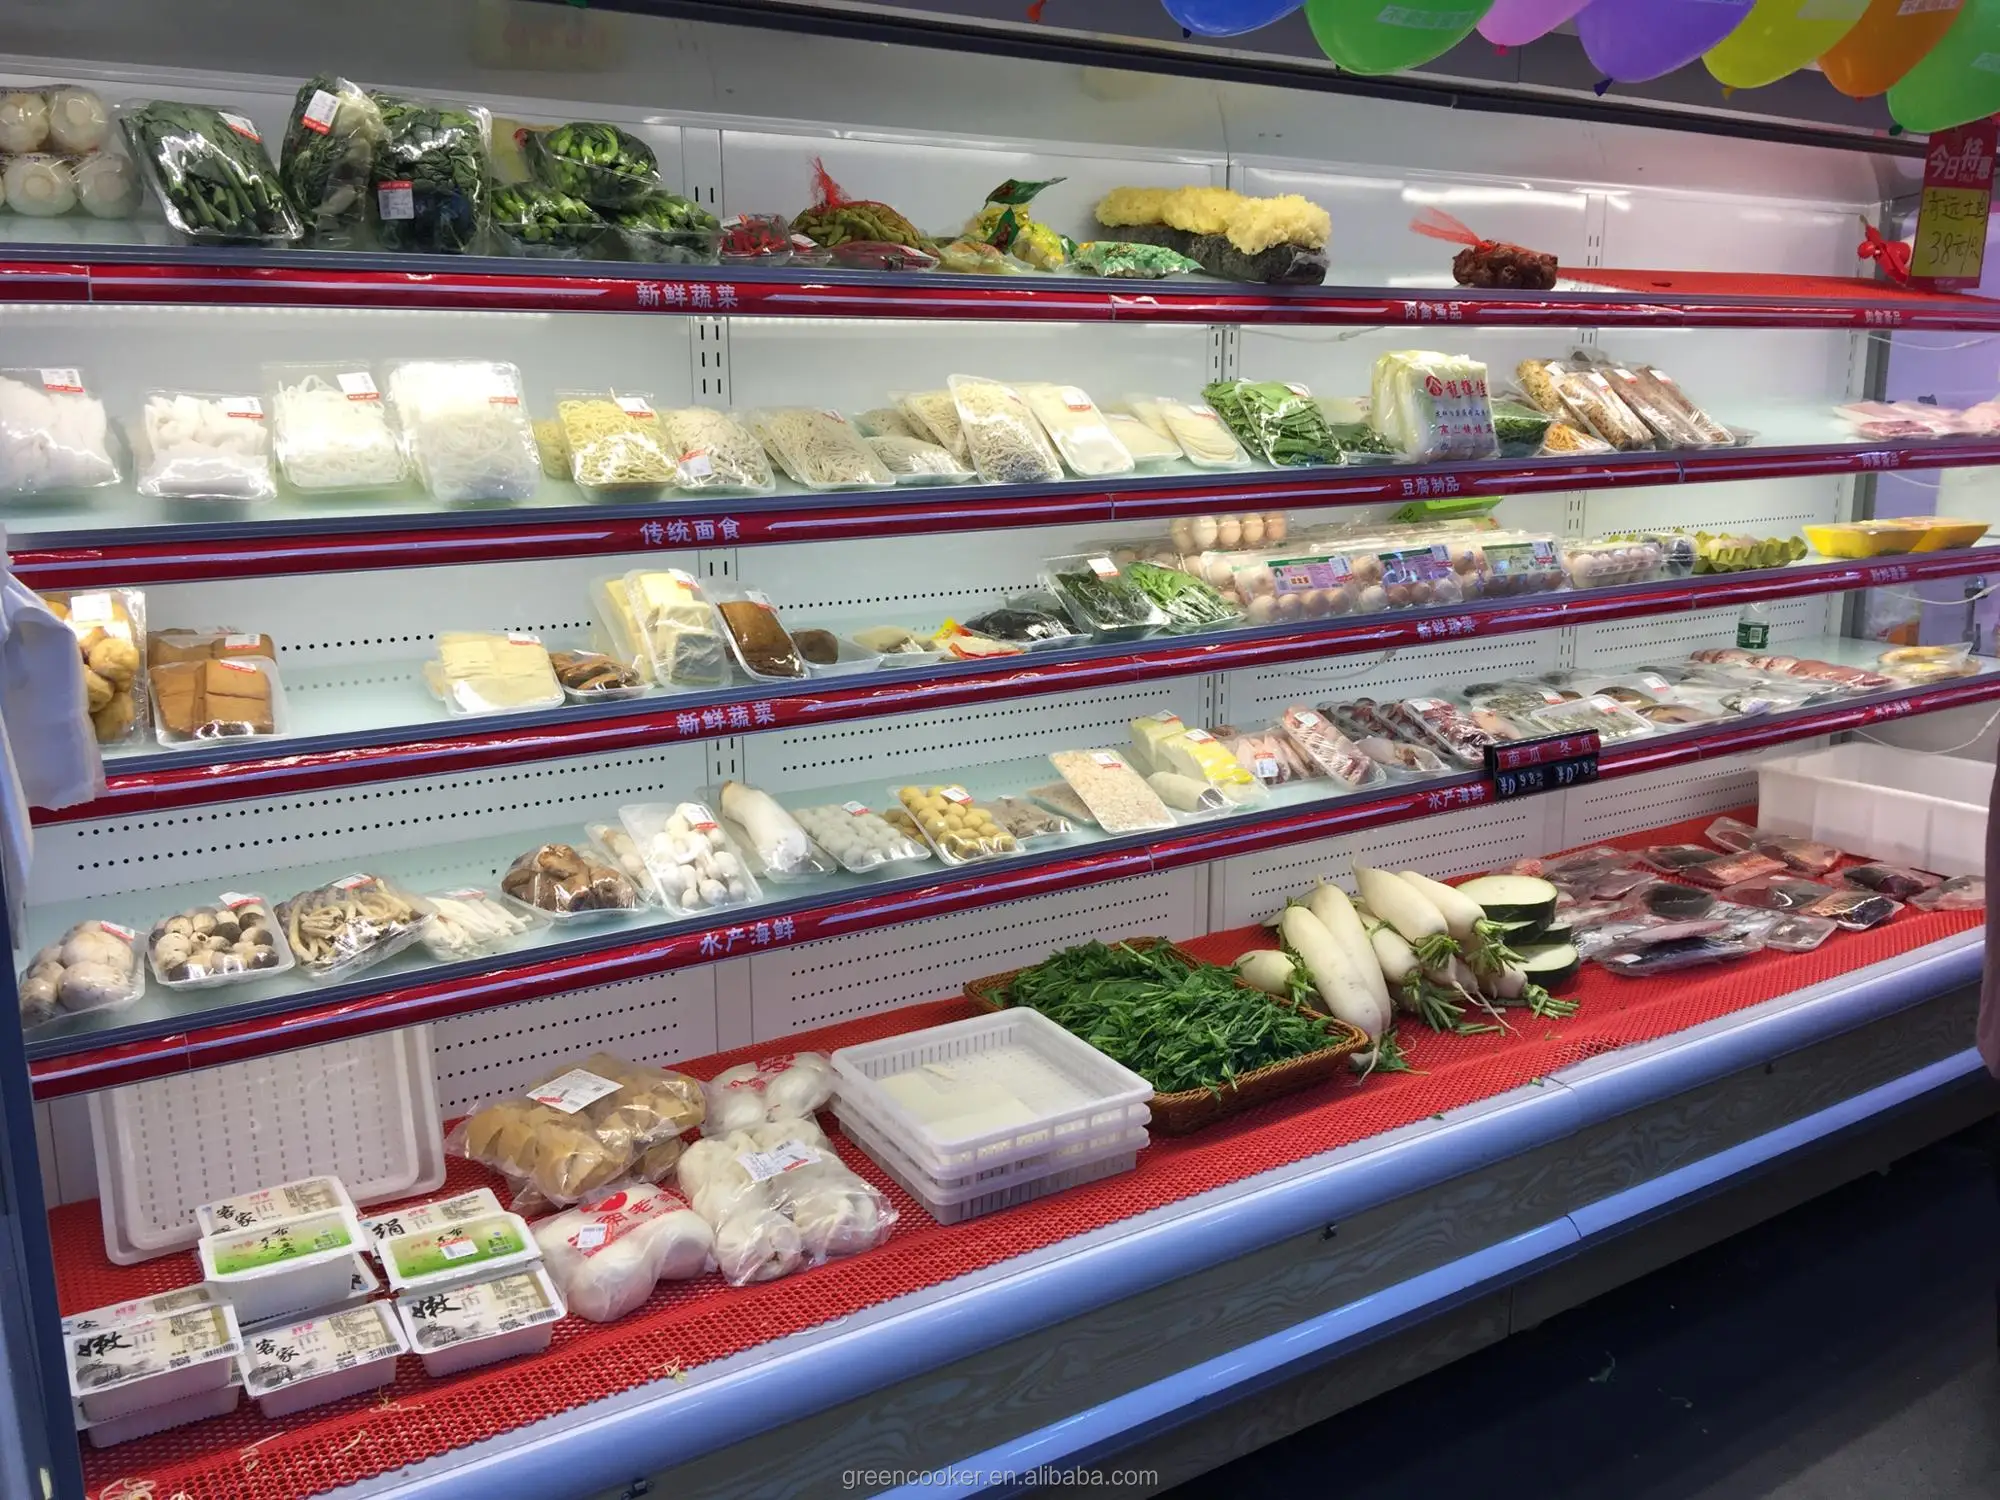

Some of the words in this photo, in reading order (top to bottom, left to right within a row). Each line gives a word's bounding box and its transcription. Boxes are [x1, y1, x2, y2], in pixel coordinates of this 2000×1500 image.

[636, 282, 738, 308] 新鲜蔬菜
[1400, 476, 1460, 496] 豆腐制品
[640, 517, 740, 545] 传统面食
[676, 702, 776, 735] 新鲜蔬菜
[1428, 784, 1485, 809] 水产海鲜
[700, 916, 796, 956] 水产海鲜
